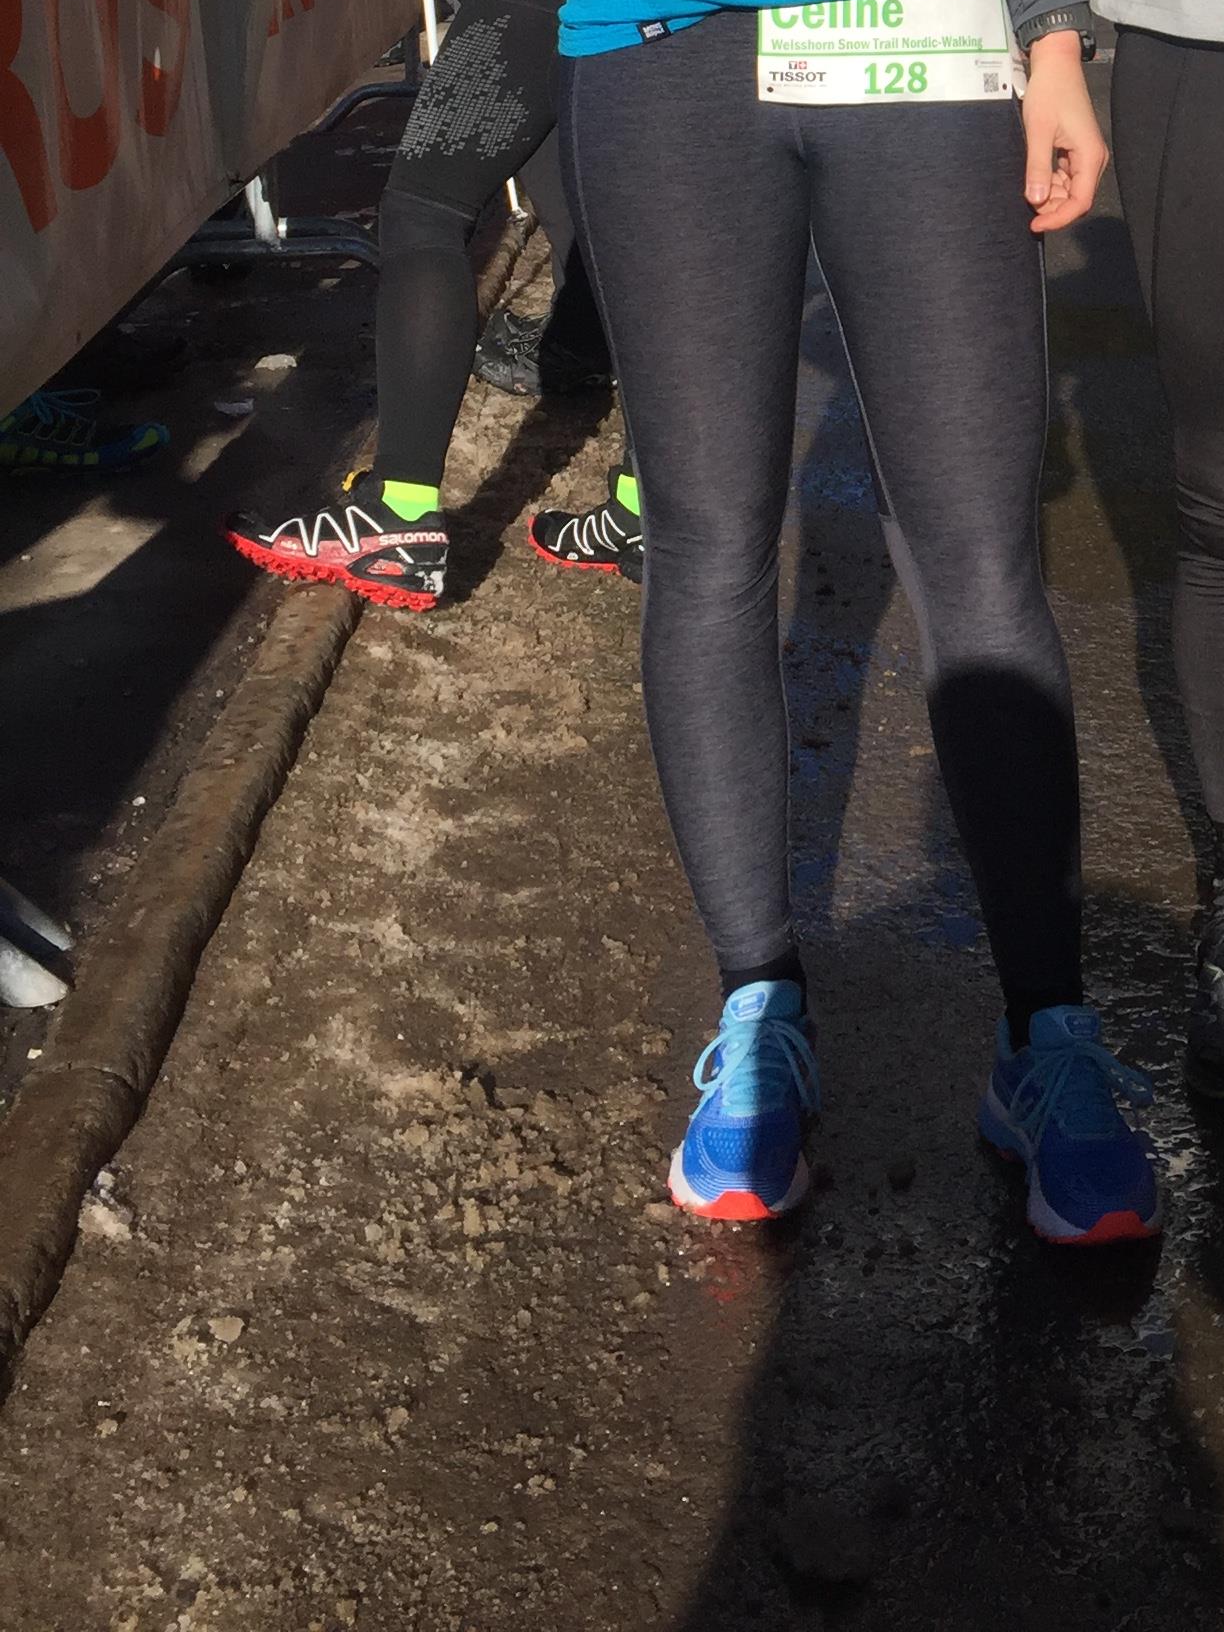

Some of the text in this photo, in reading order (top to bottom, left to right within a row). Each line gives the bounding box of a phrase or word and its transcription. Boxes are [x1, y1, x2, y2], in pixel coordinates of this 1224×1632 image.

[771, 35, 983, 50] Weisshorn Snow Trail Nordic-Walking
[769, 71, 827, 82] TISSOT
[864, 62, 928, 94] 128
[379, 532, 446, 546] salomon
